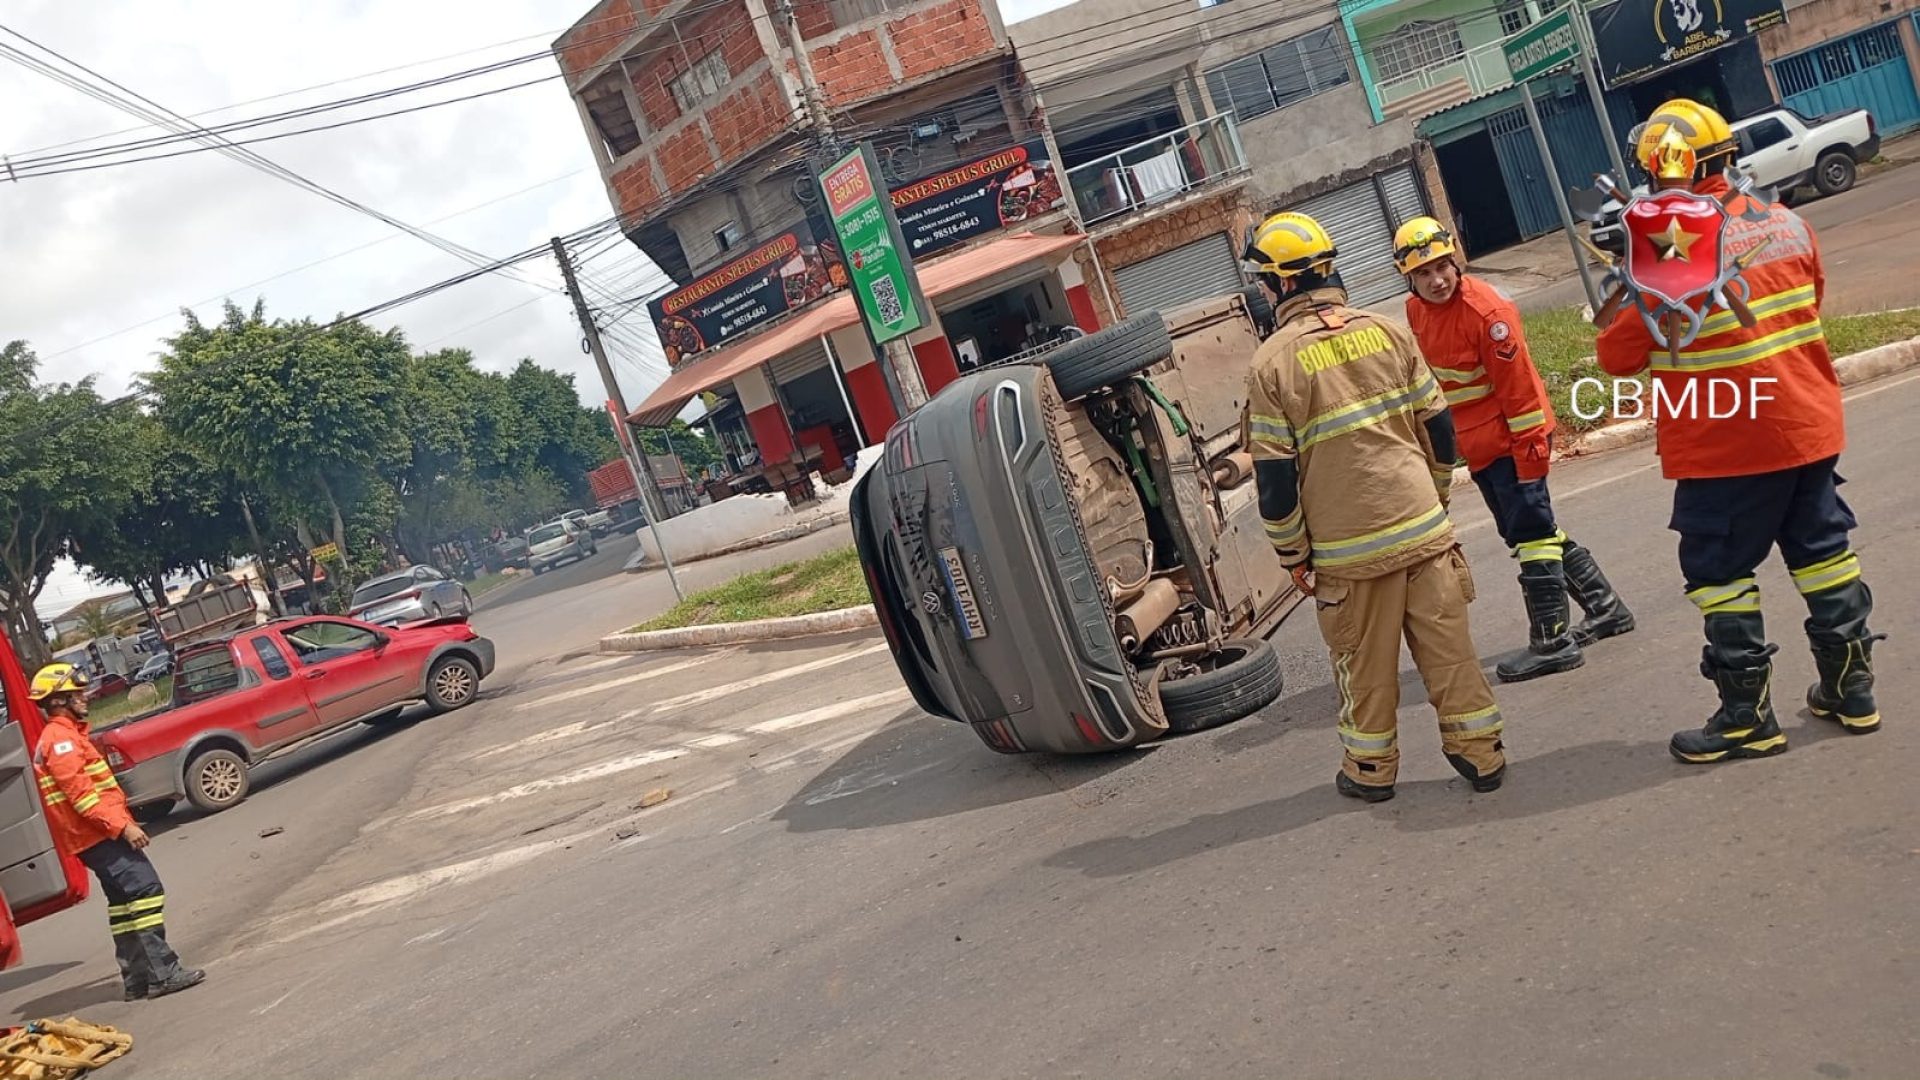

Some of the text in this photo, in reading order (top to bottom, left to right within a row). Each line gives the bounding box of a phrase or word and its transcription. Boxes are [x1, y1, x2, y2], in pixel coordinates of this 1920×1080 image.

[1673, 36, 1723, 59] BARBEARIA
[1685, 31, 1708, 45] ABEL
[828, 164, 860, 190] ENTREGA
[931, 168, 978, 192] SPETUS
[980, 152, 1020, 175] GRILL
[923, 203, 949, 216] Mineira
[932, 216, 979, 240] 98518-6843
[668, 239, 791, 312] RESTAURANTE SPETUS GRILL
[1296, 327, 1393, 376] BOMBEIROS
[946, 557, 981, 629] RHV1D03
